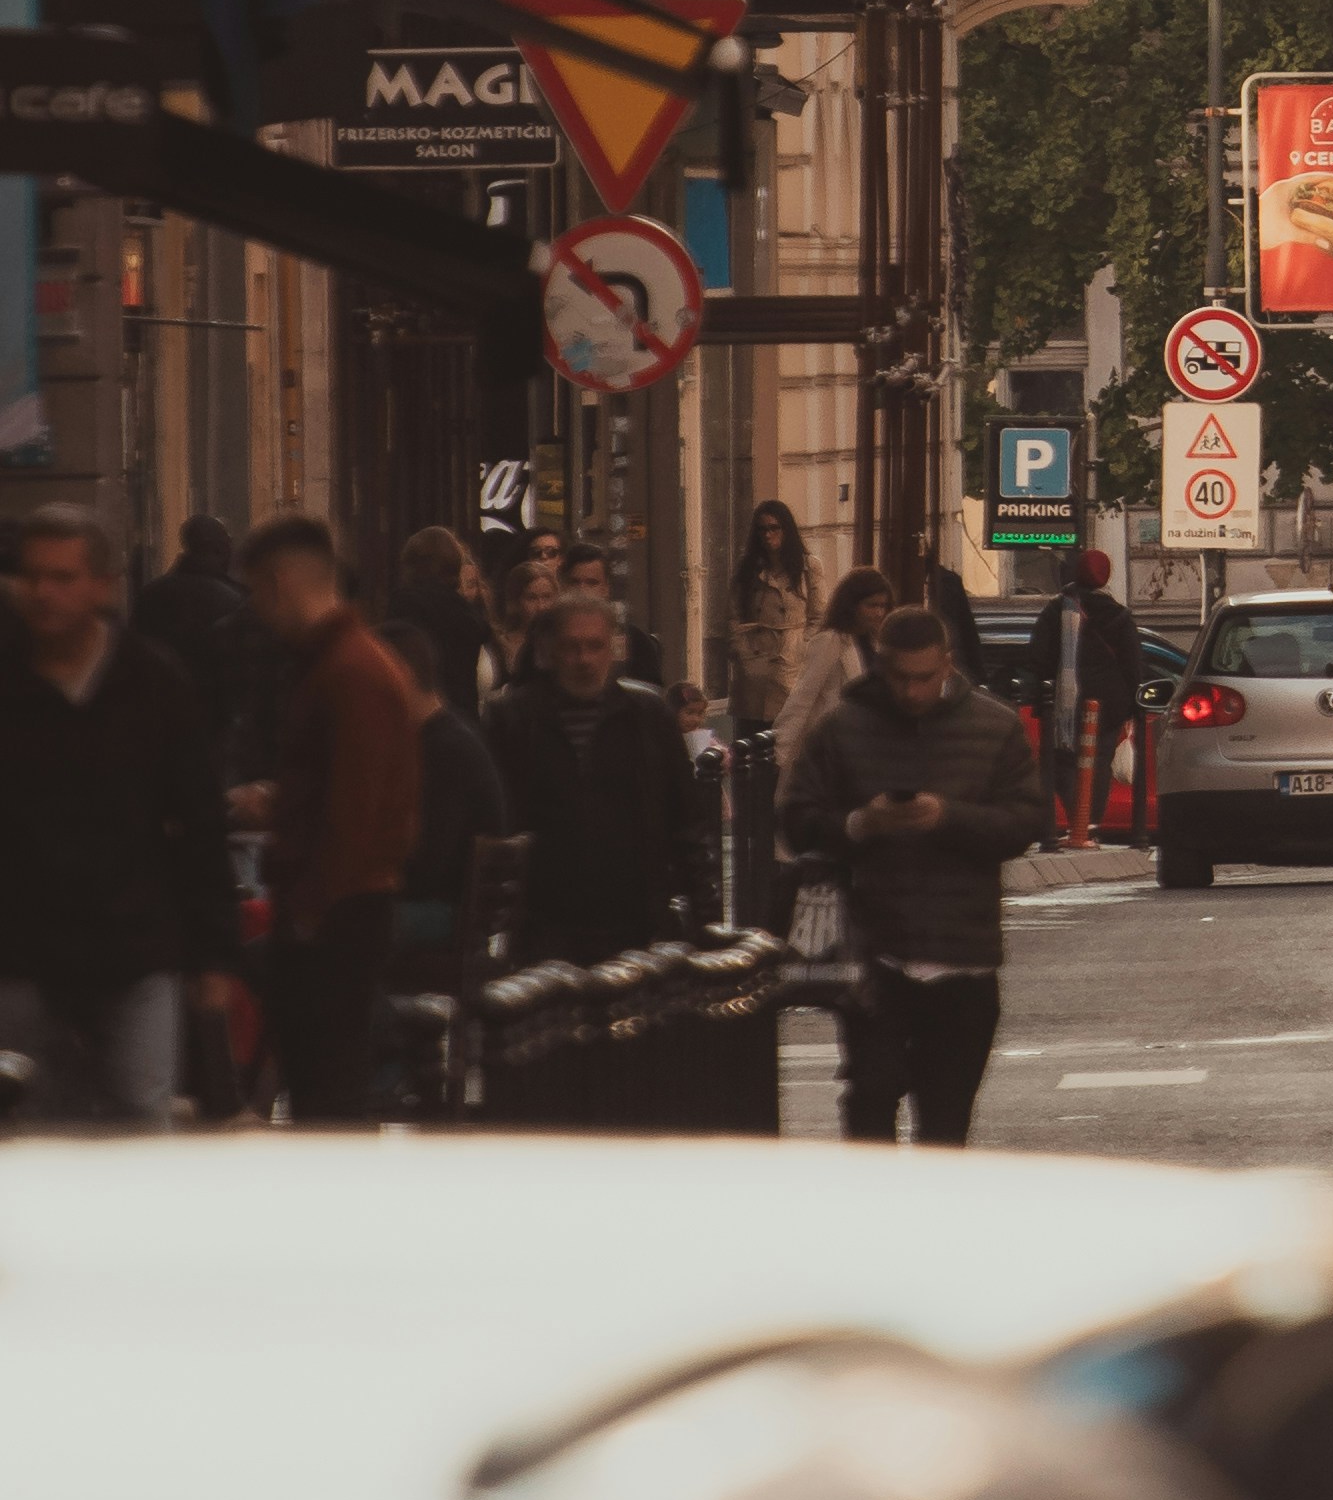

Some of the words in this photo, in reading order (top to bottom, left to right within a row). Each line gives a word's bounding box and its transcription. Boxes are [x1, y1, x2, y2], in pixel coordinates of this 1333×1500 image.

[337, 123, 551, 141] FRIZERSKO-KOZMETIČKI
[415, 144, 475, 158] SALON
[1016, 439, 1054, 488] P
[1195, 481, 1224, 506] 40
[997, 504, 1071, 517] PARKING
[1167, 530, 1181, 538] na
[1184, 528, 1217, 538] dužini
